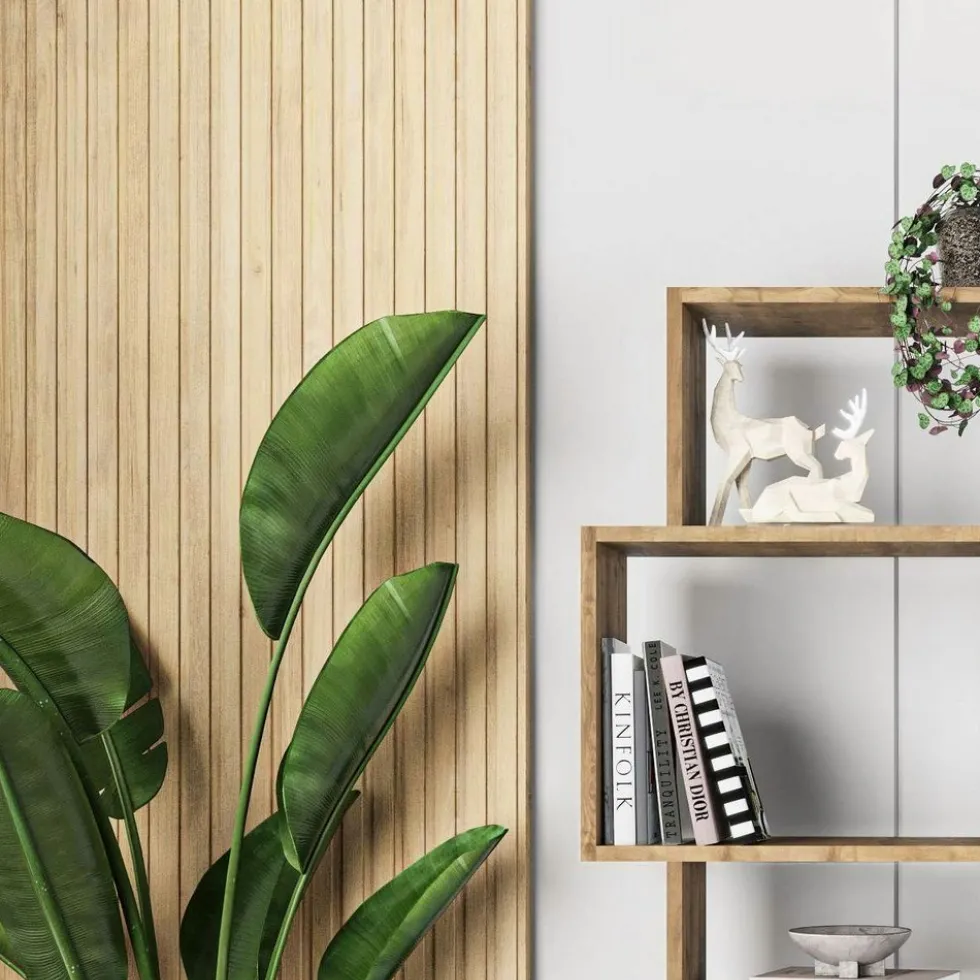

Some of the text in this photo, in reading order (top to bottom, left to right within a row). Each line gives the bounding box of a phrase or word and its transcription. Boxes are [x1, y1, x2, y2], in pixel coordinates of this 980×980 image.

[648, 643, 658, 670] COLE
[654, 692, 663, 710] LEE
[614, 692, 633, 811] KINFOLK
[655, 729, 677, 839] TRANQUILITY
[669, 680, 710, 822] BY CHRISTIAN DIOR
